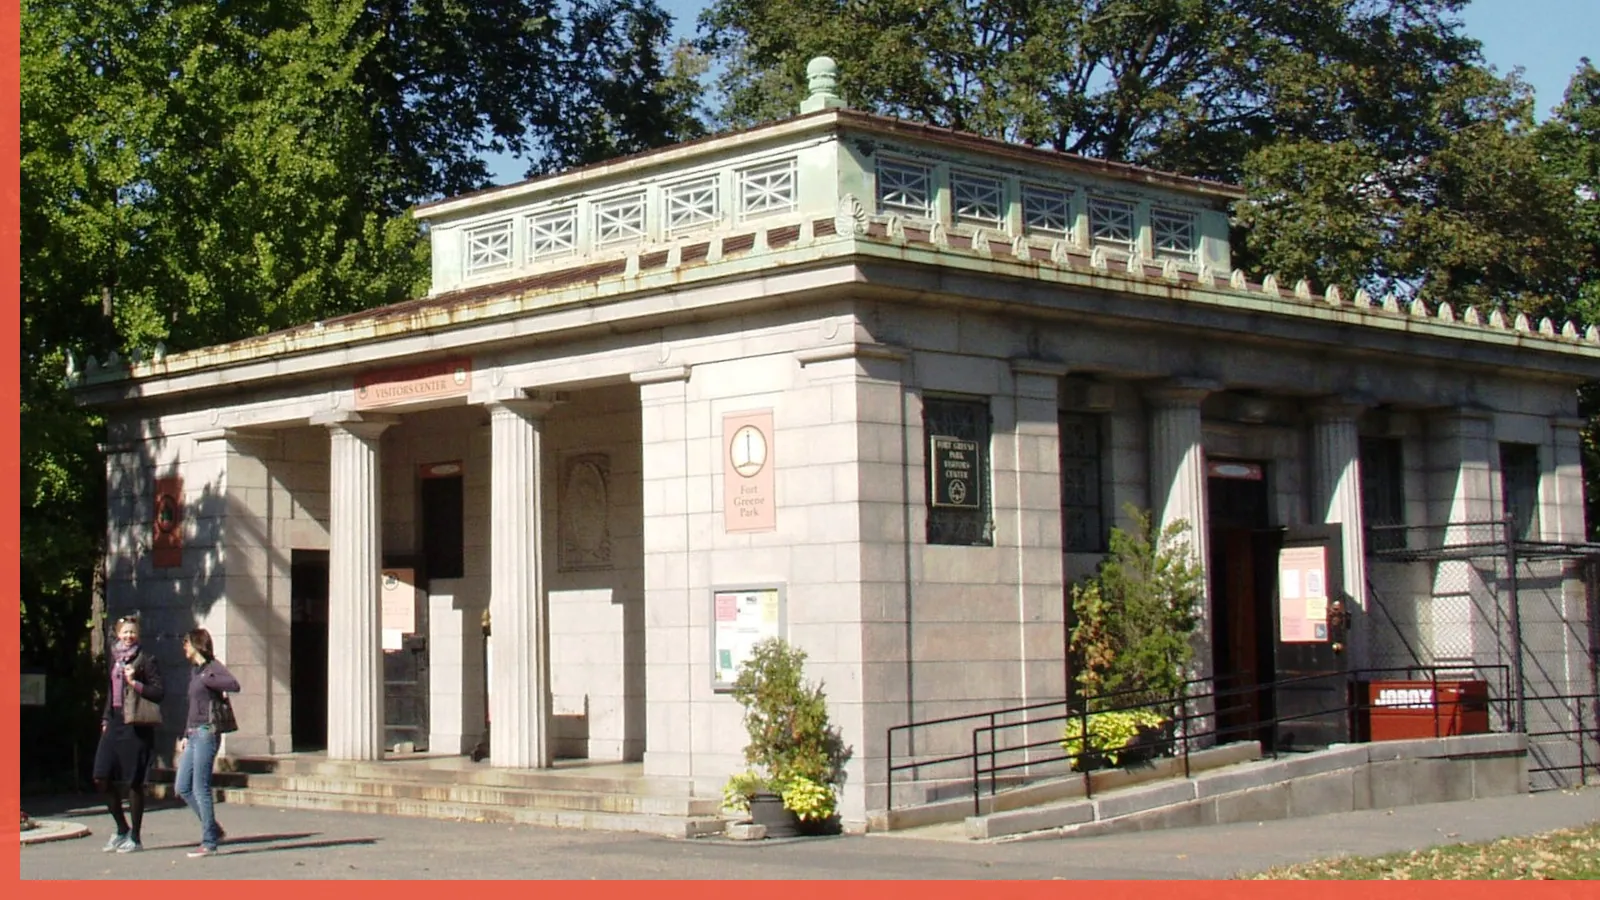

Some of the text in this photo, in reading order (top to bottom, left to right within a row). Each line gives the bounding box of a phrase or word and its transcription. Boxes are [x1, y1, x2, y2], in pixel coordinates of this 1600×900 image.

[375, 380, 447, 398] VISITORS CENTER
[740, 485, 758, 494] Fort
[733, 497, 765, 506] Greene
[740, 507, 759, 517] Park
